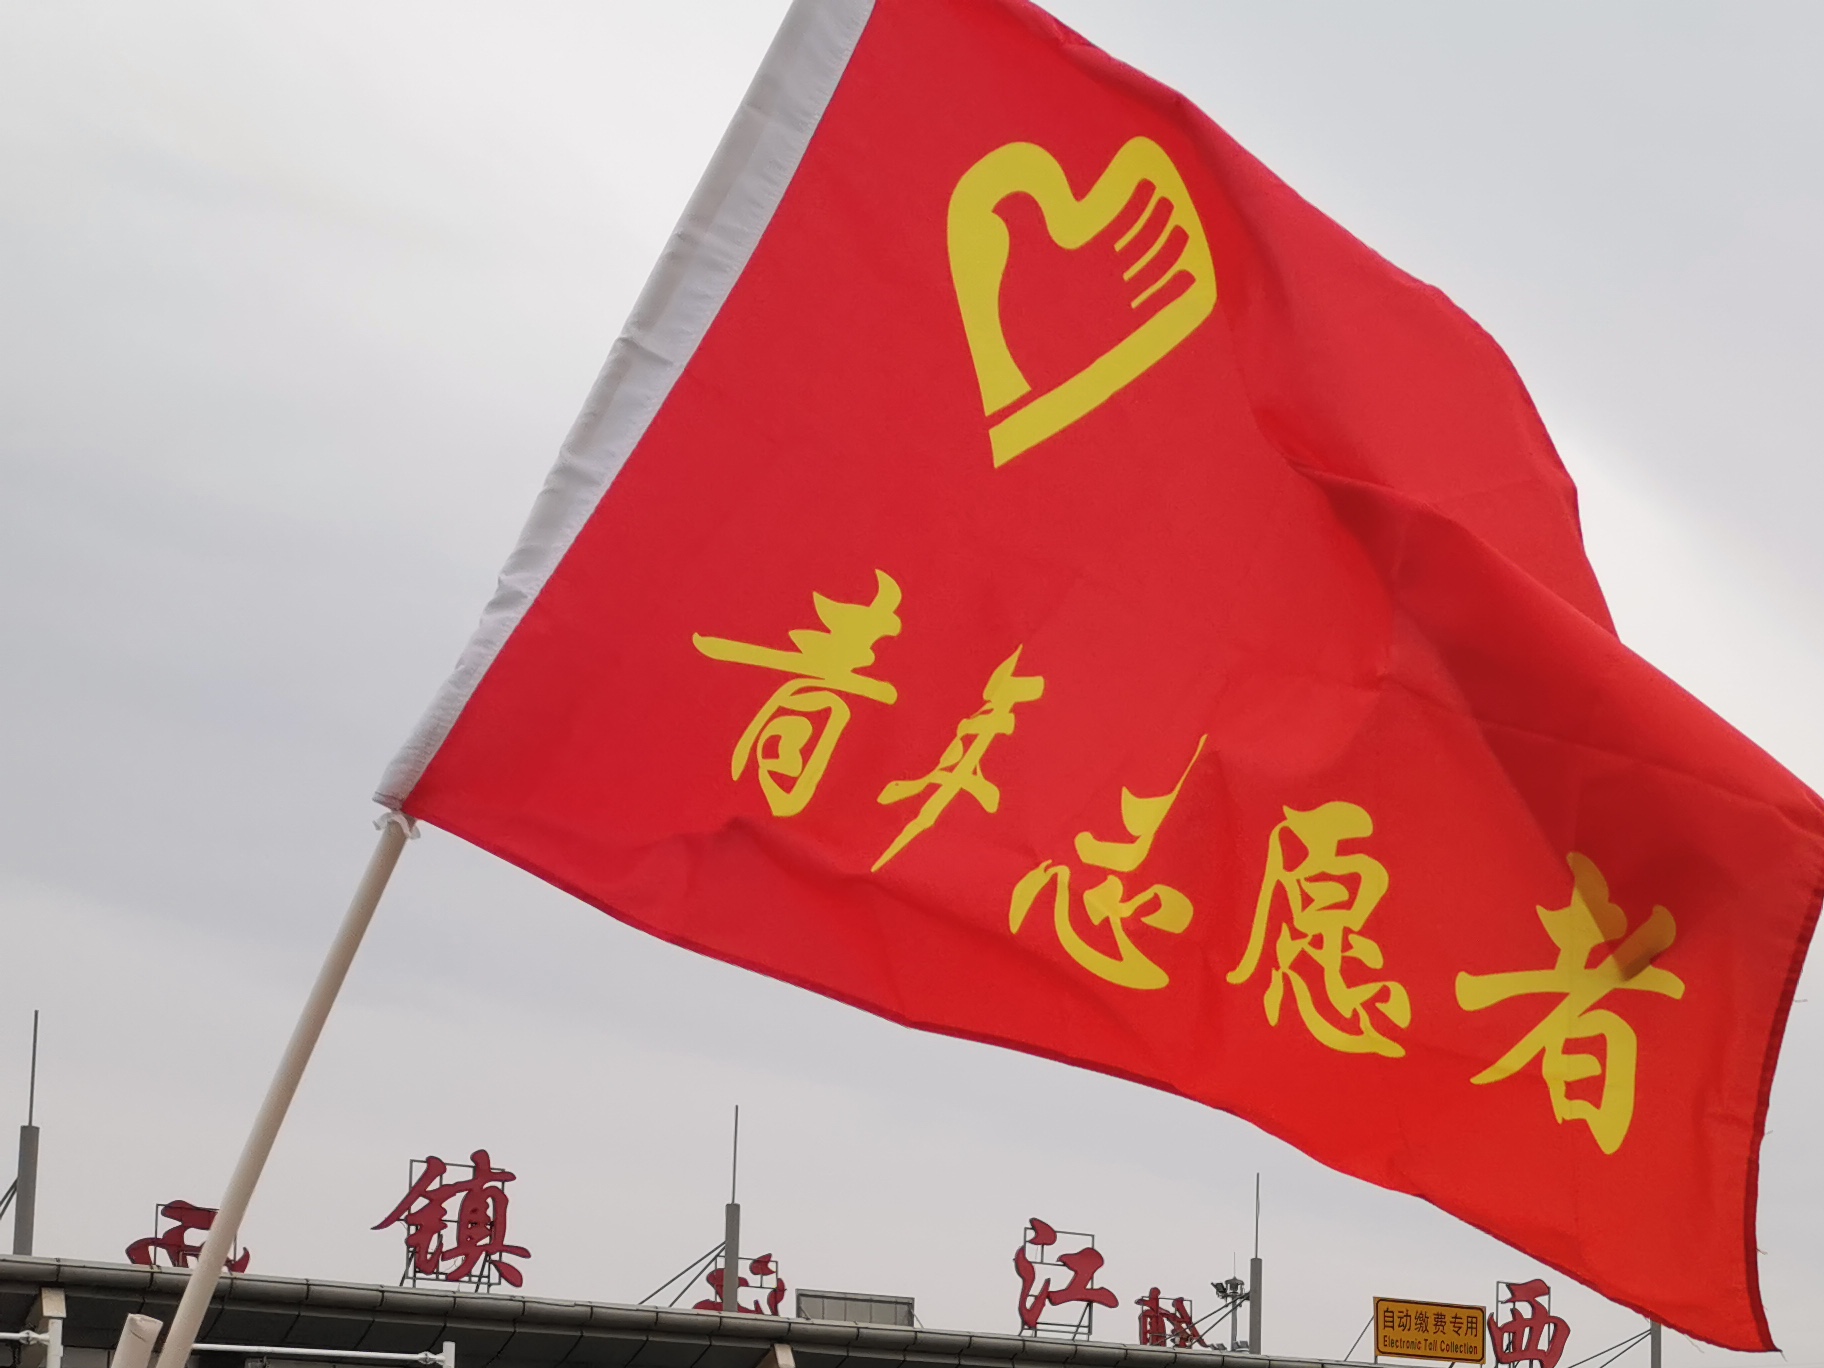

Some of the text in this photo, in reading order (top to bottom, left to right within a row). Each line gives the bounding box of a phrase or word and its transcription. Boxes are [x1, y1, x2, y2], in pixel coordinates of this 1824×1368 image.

[692, 569, 1685, 1154] 青年志愿者
[1383, 1308, 1479, 1338] 自动缴费专用
[1383, 1335, 1422, 1351] Electronic
[1440, 1340, 1479, 1355] Collection
